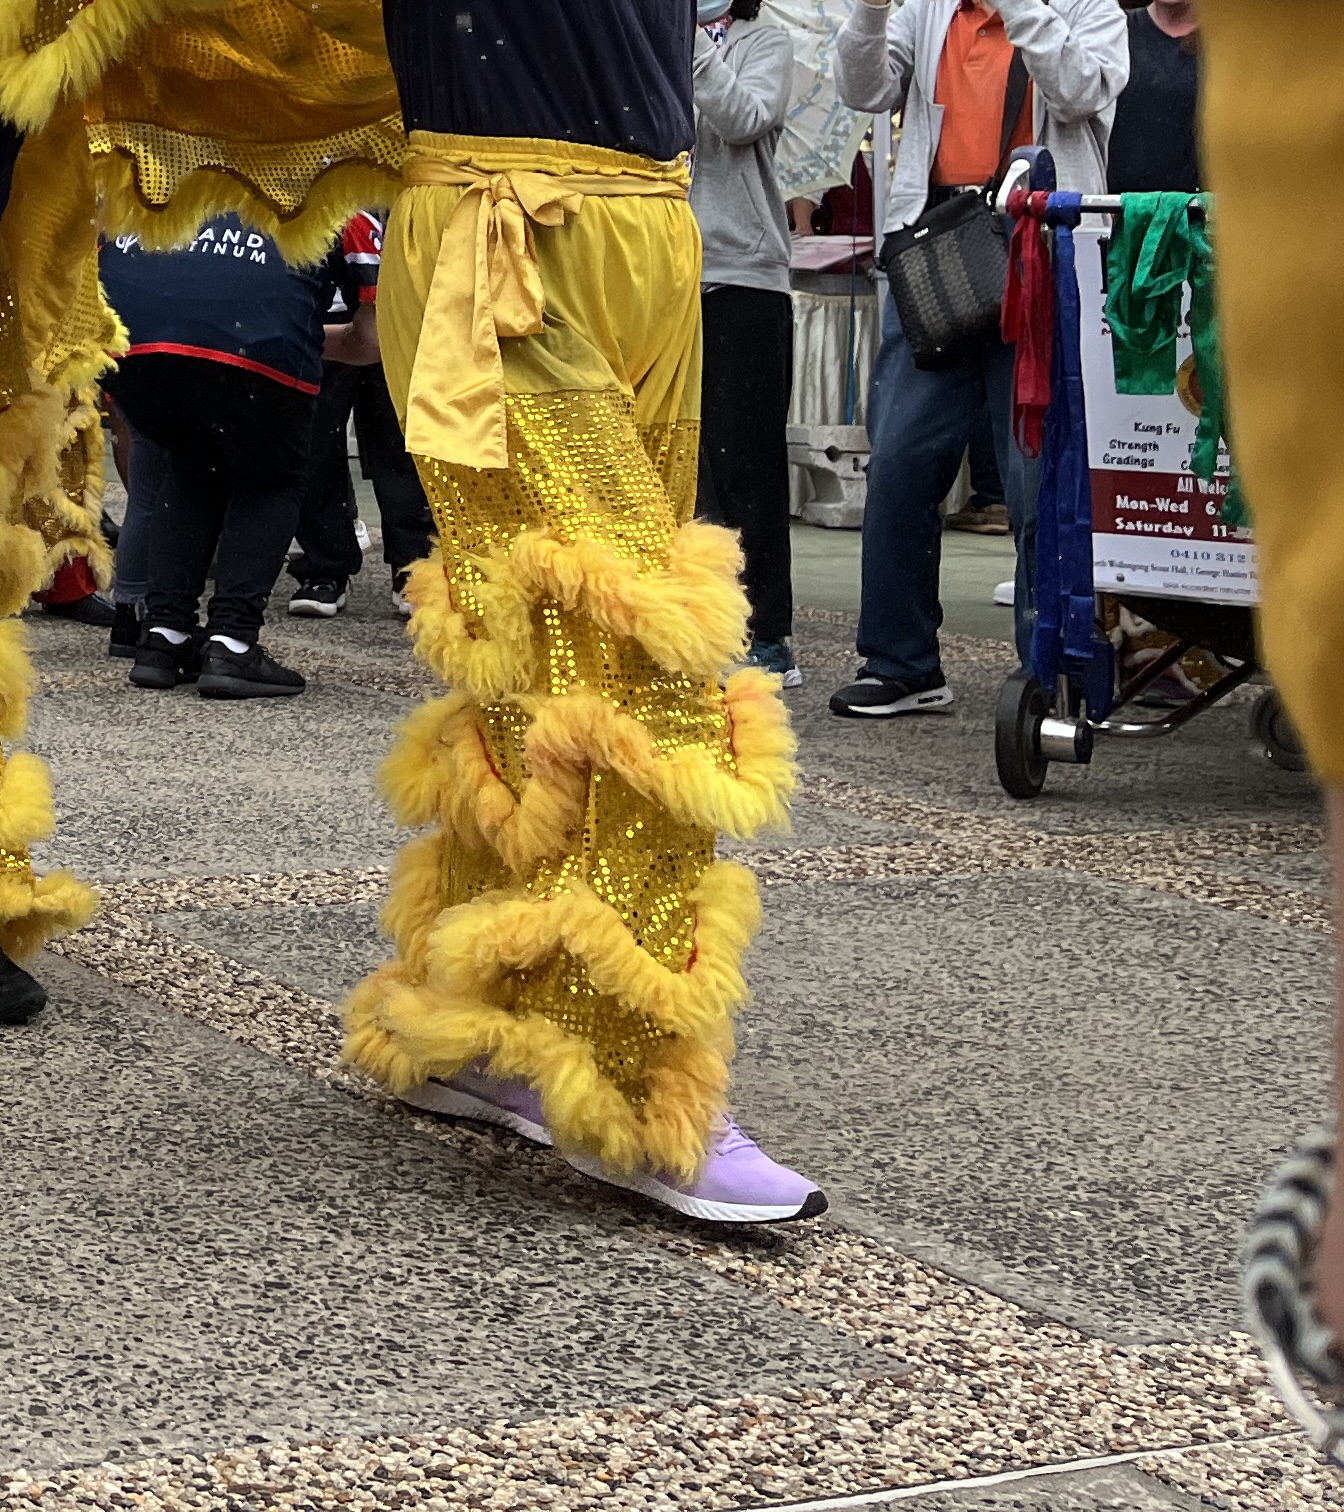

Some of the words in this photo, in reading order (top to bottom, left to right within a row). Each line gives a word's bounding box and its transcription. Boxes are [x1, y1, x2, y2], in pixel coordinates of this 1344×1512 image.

[198, 228, 264, 248] AND
[1134, 421, 1162, 436] Kung
[1165, 423, 1181, 434] Fu
[1108, 438, 1160, 453] Strength
[1102, 453, 1155, 469] Gradings
[1176, 476, 1194, 494] All
[1197, 478, 1229, 496] Welc
[1116, 495, 1189, 513] Mon-Wed
[1115, 517, 1194, 536] Saturday
